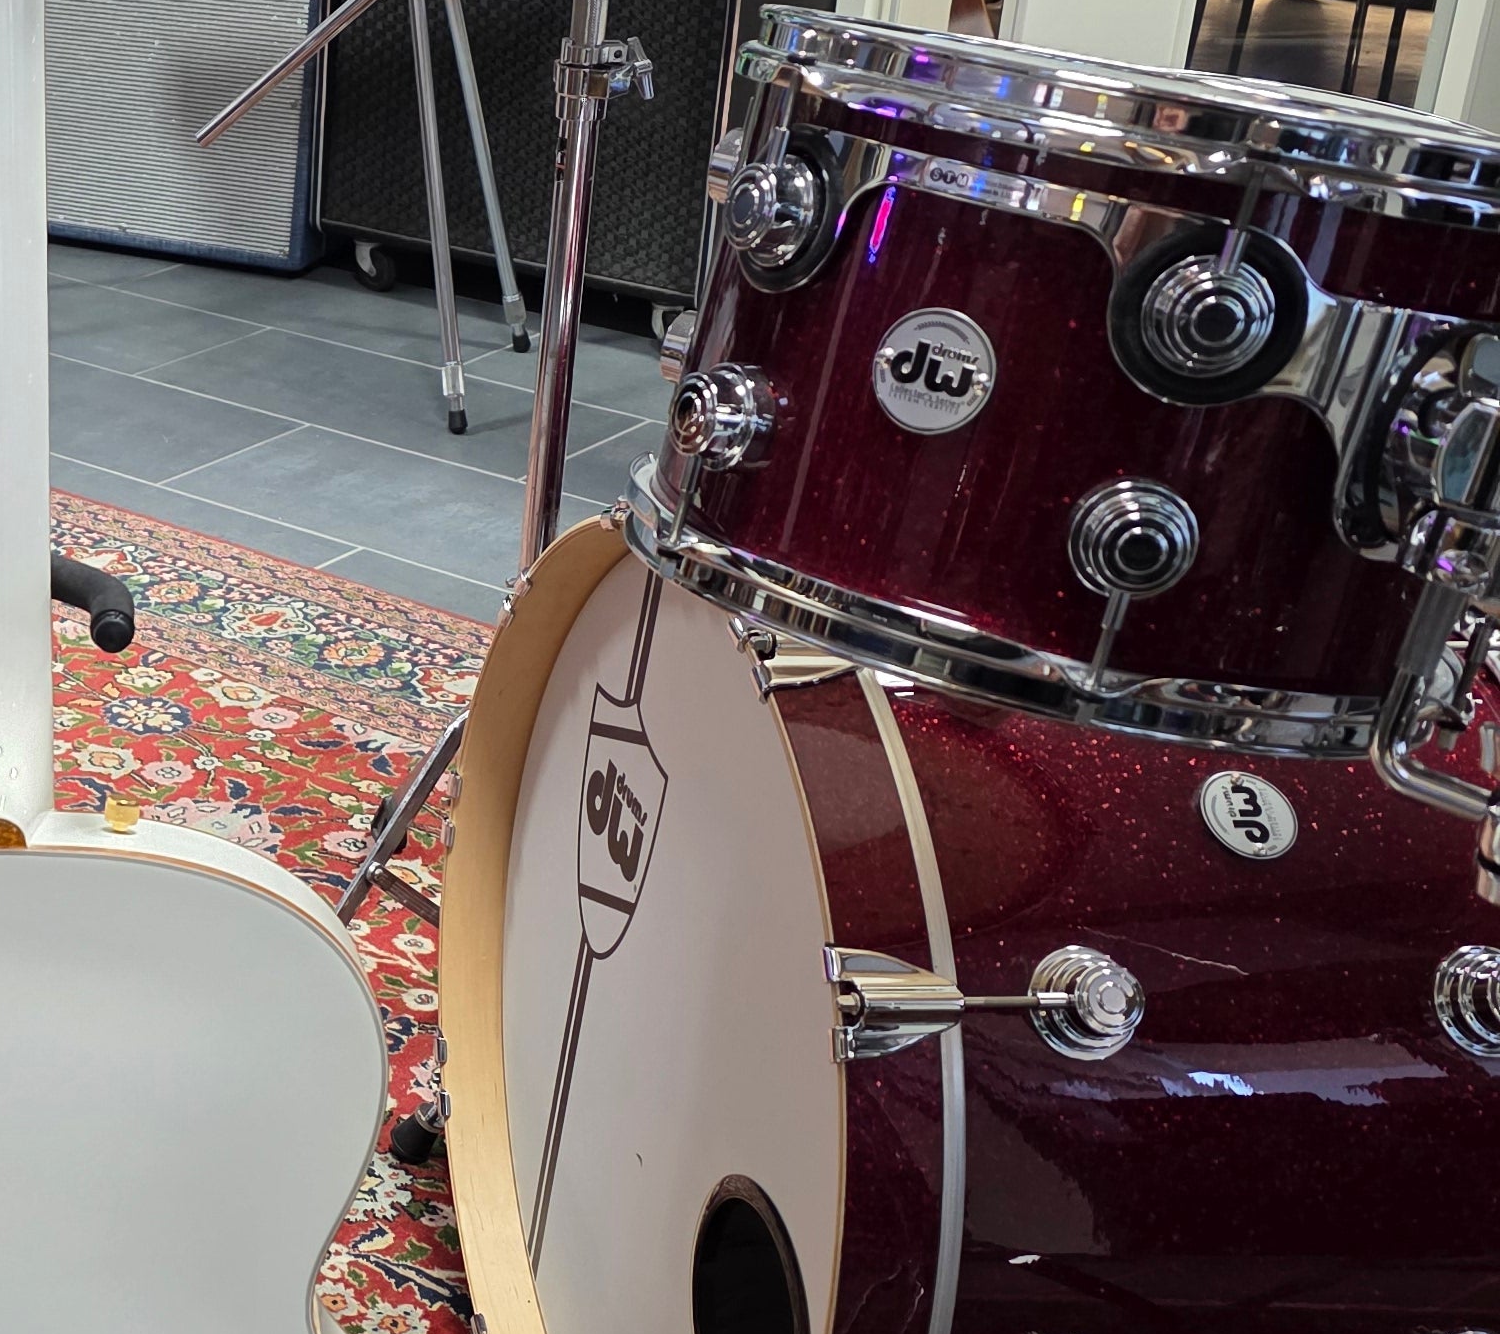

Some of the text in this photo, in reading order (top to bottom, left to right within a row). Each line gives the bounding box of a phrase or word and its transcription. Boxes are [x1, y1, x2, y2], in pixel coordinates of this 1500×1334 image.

[929, 167, 969, 188] STM
[890, 338, 977, 398] dw
[932, 342, 980, 365] drums
[587, 759, 643, 882] dw
[617, 772, 648, 827] drums
[1222, 786, 1237, 817] drums
[1231, 786, 1270, 844] dw
